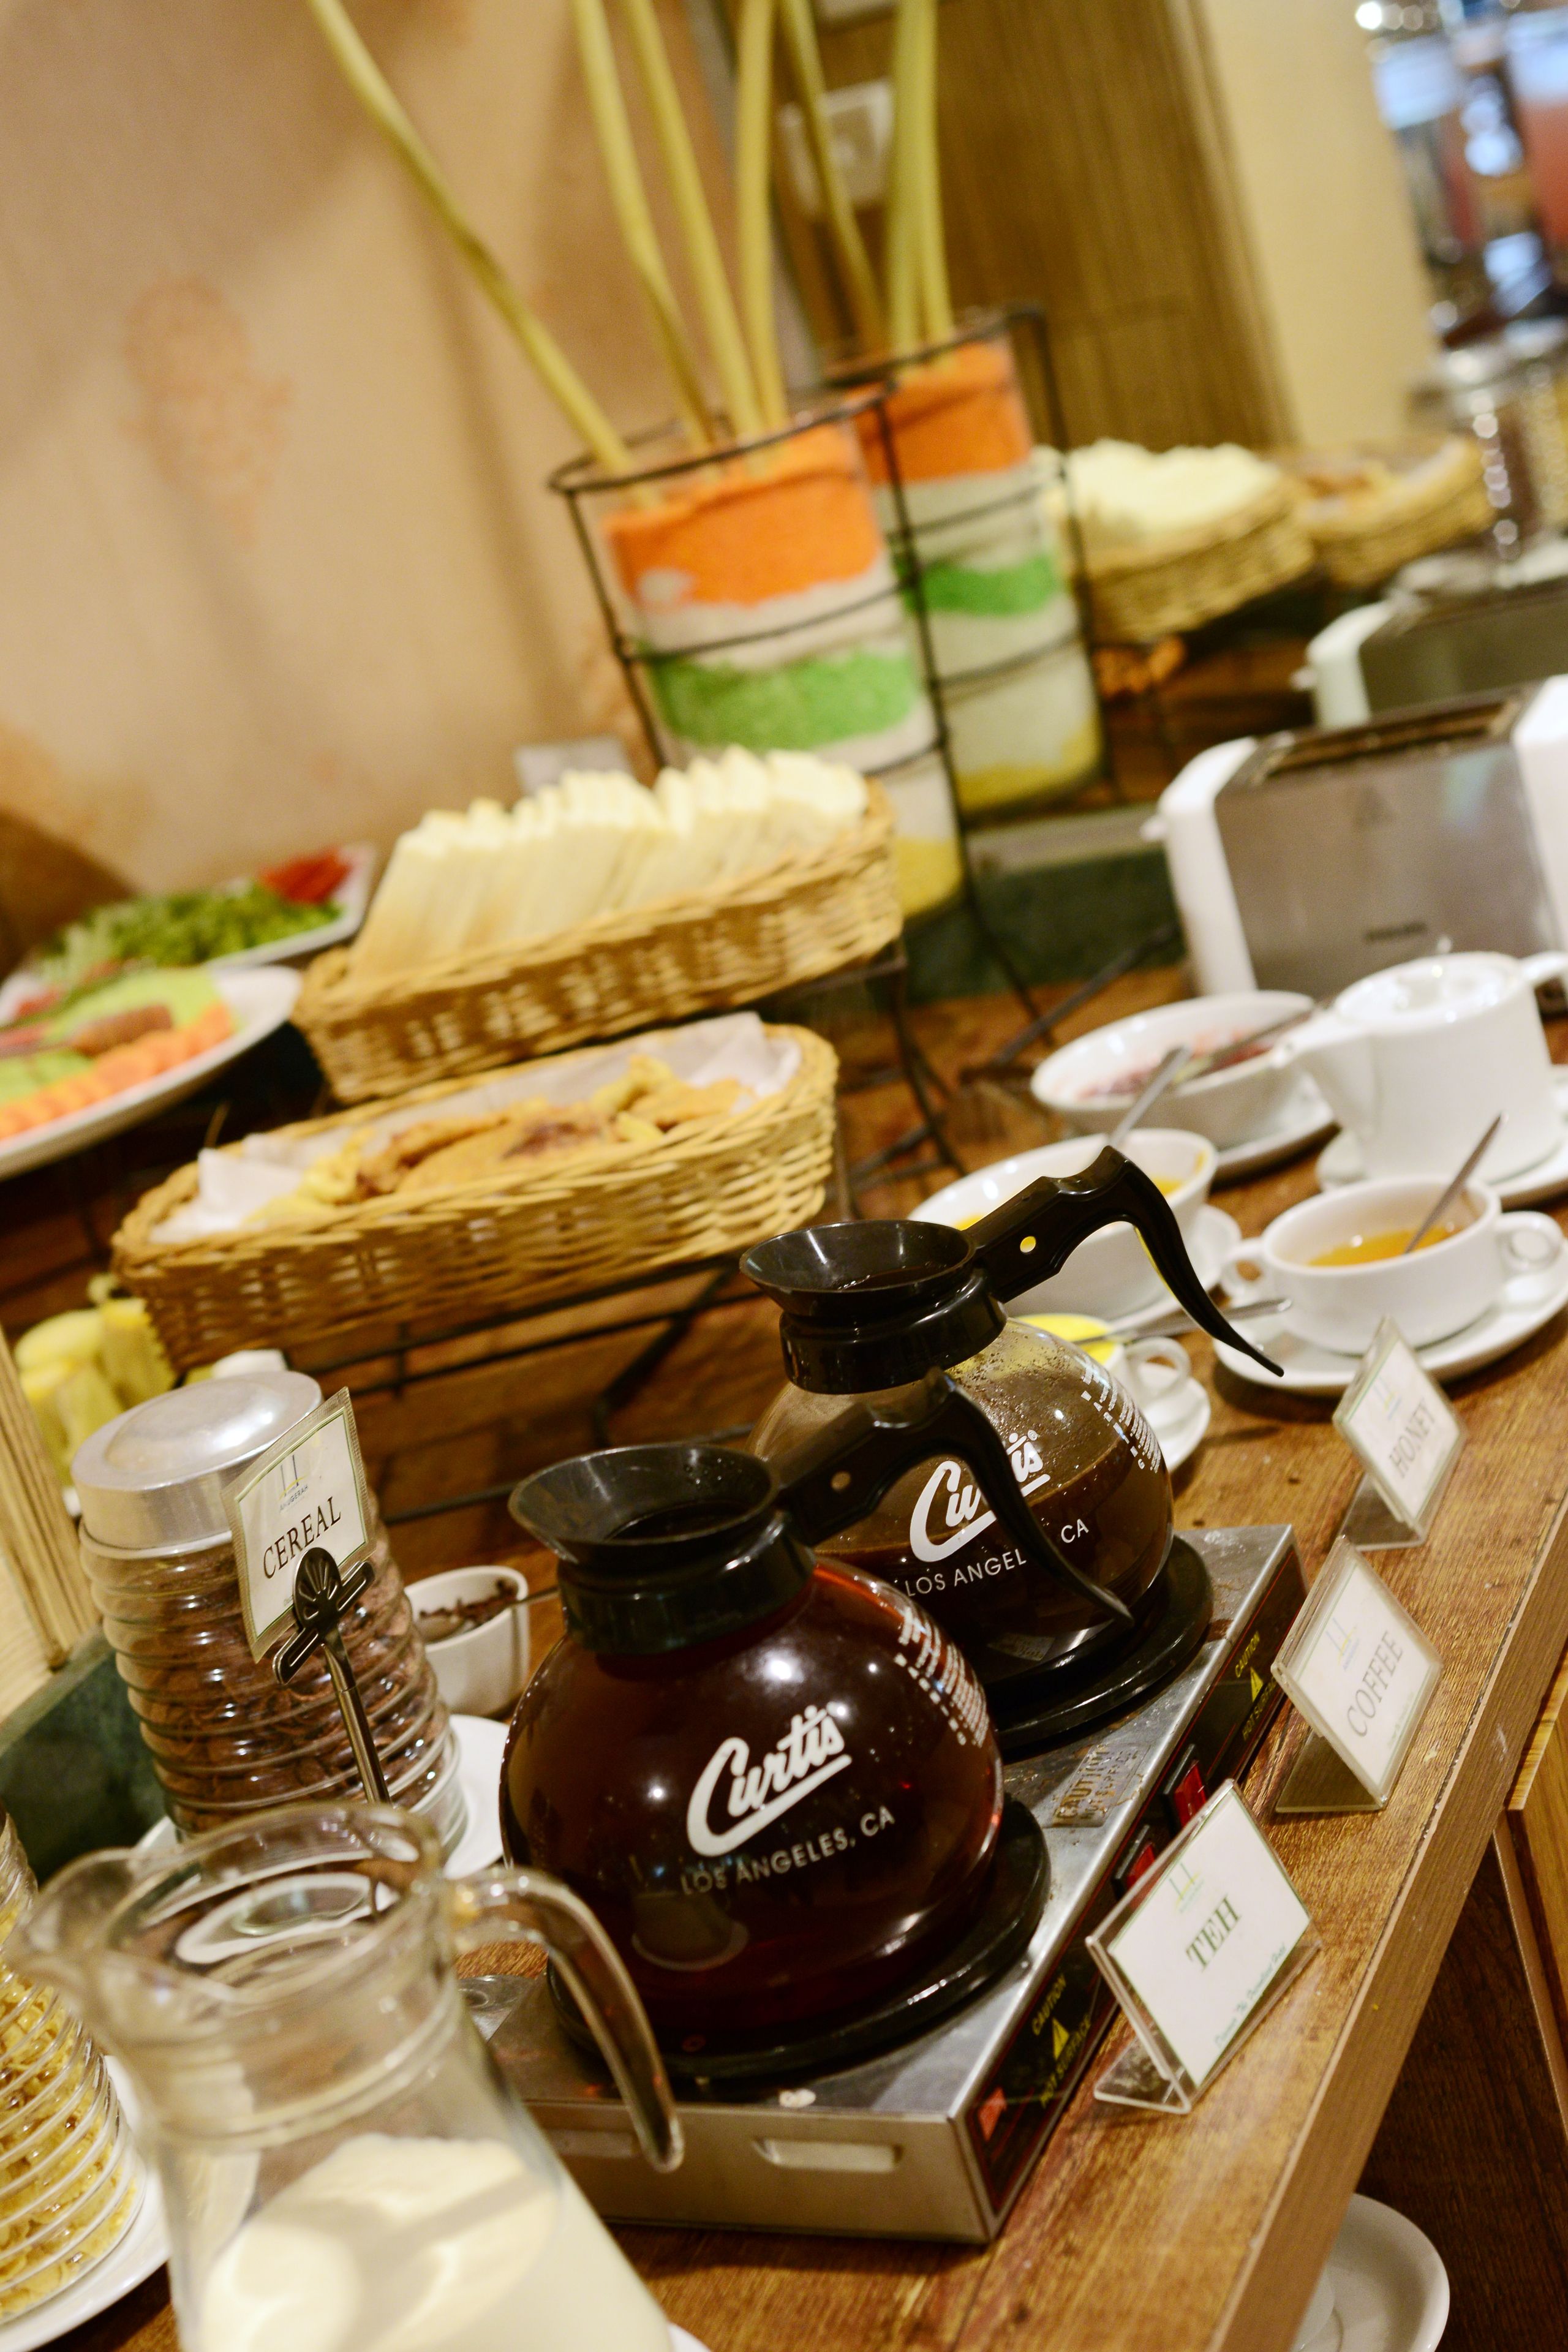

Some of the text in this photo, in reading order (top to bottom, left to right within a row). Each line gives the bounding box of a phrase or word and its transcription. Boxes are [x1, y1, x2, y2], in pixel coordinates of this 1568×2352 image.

[263, 1496, 341, 1579] CEREAL
[910, 1432, 1050, 1562] Cuis
[905, 1518, 1089, 1597] LOS ANGEL CA
[1235, 1630, 1261, 1678] CAUTION
[1347, 1629, 1403, 1737] COFFEE
[1254, 1675, 1277, 1719] SURFAC
[687, 1704, 852, 1857] Curtis
[680, 1805, 895, 1895] LOS ANGELES, CA
[1185, 1894, 1242, 1972] TEH
[1032, 1973, 1067, 2036] CAUTION
